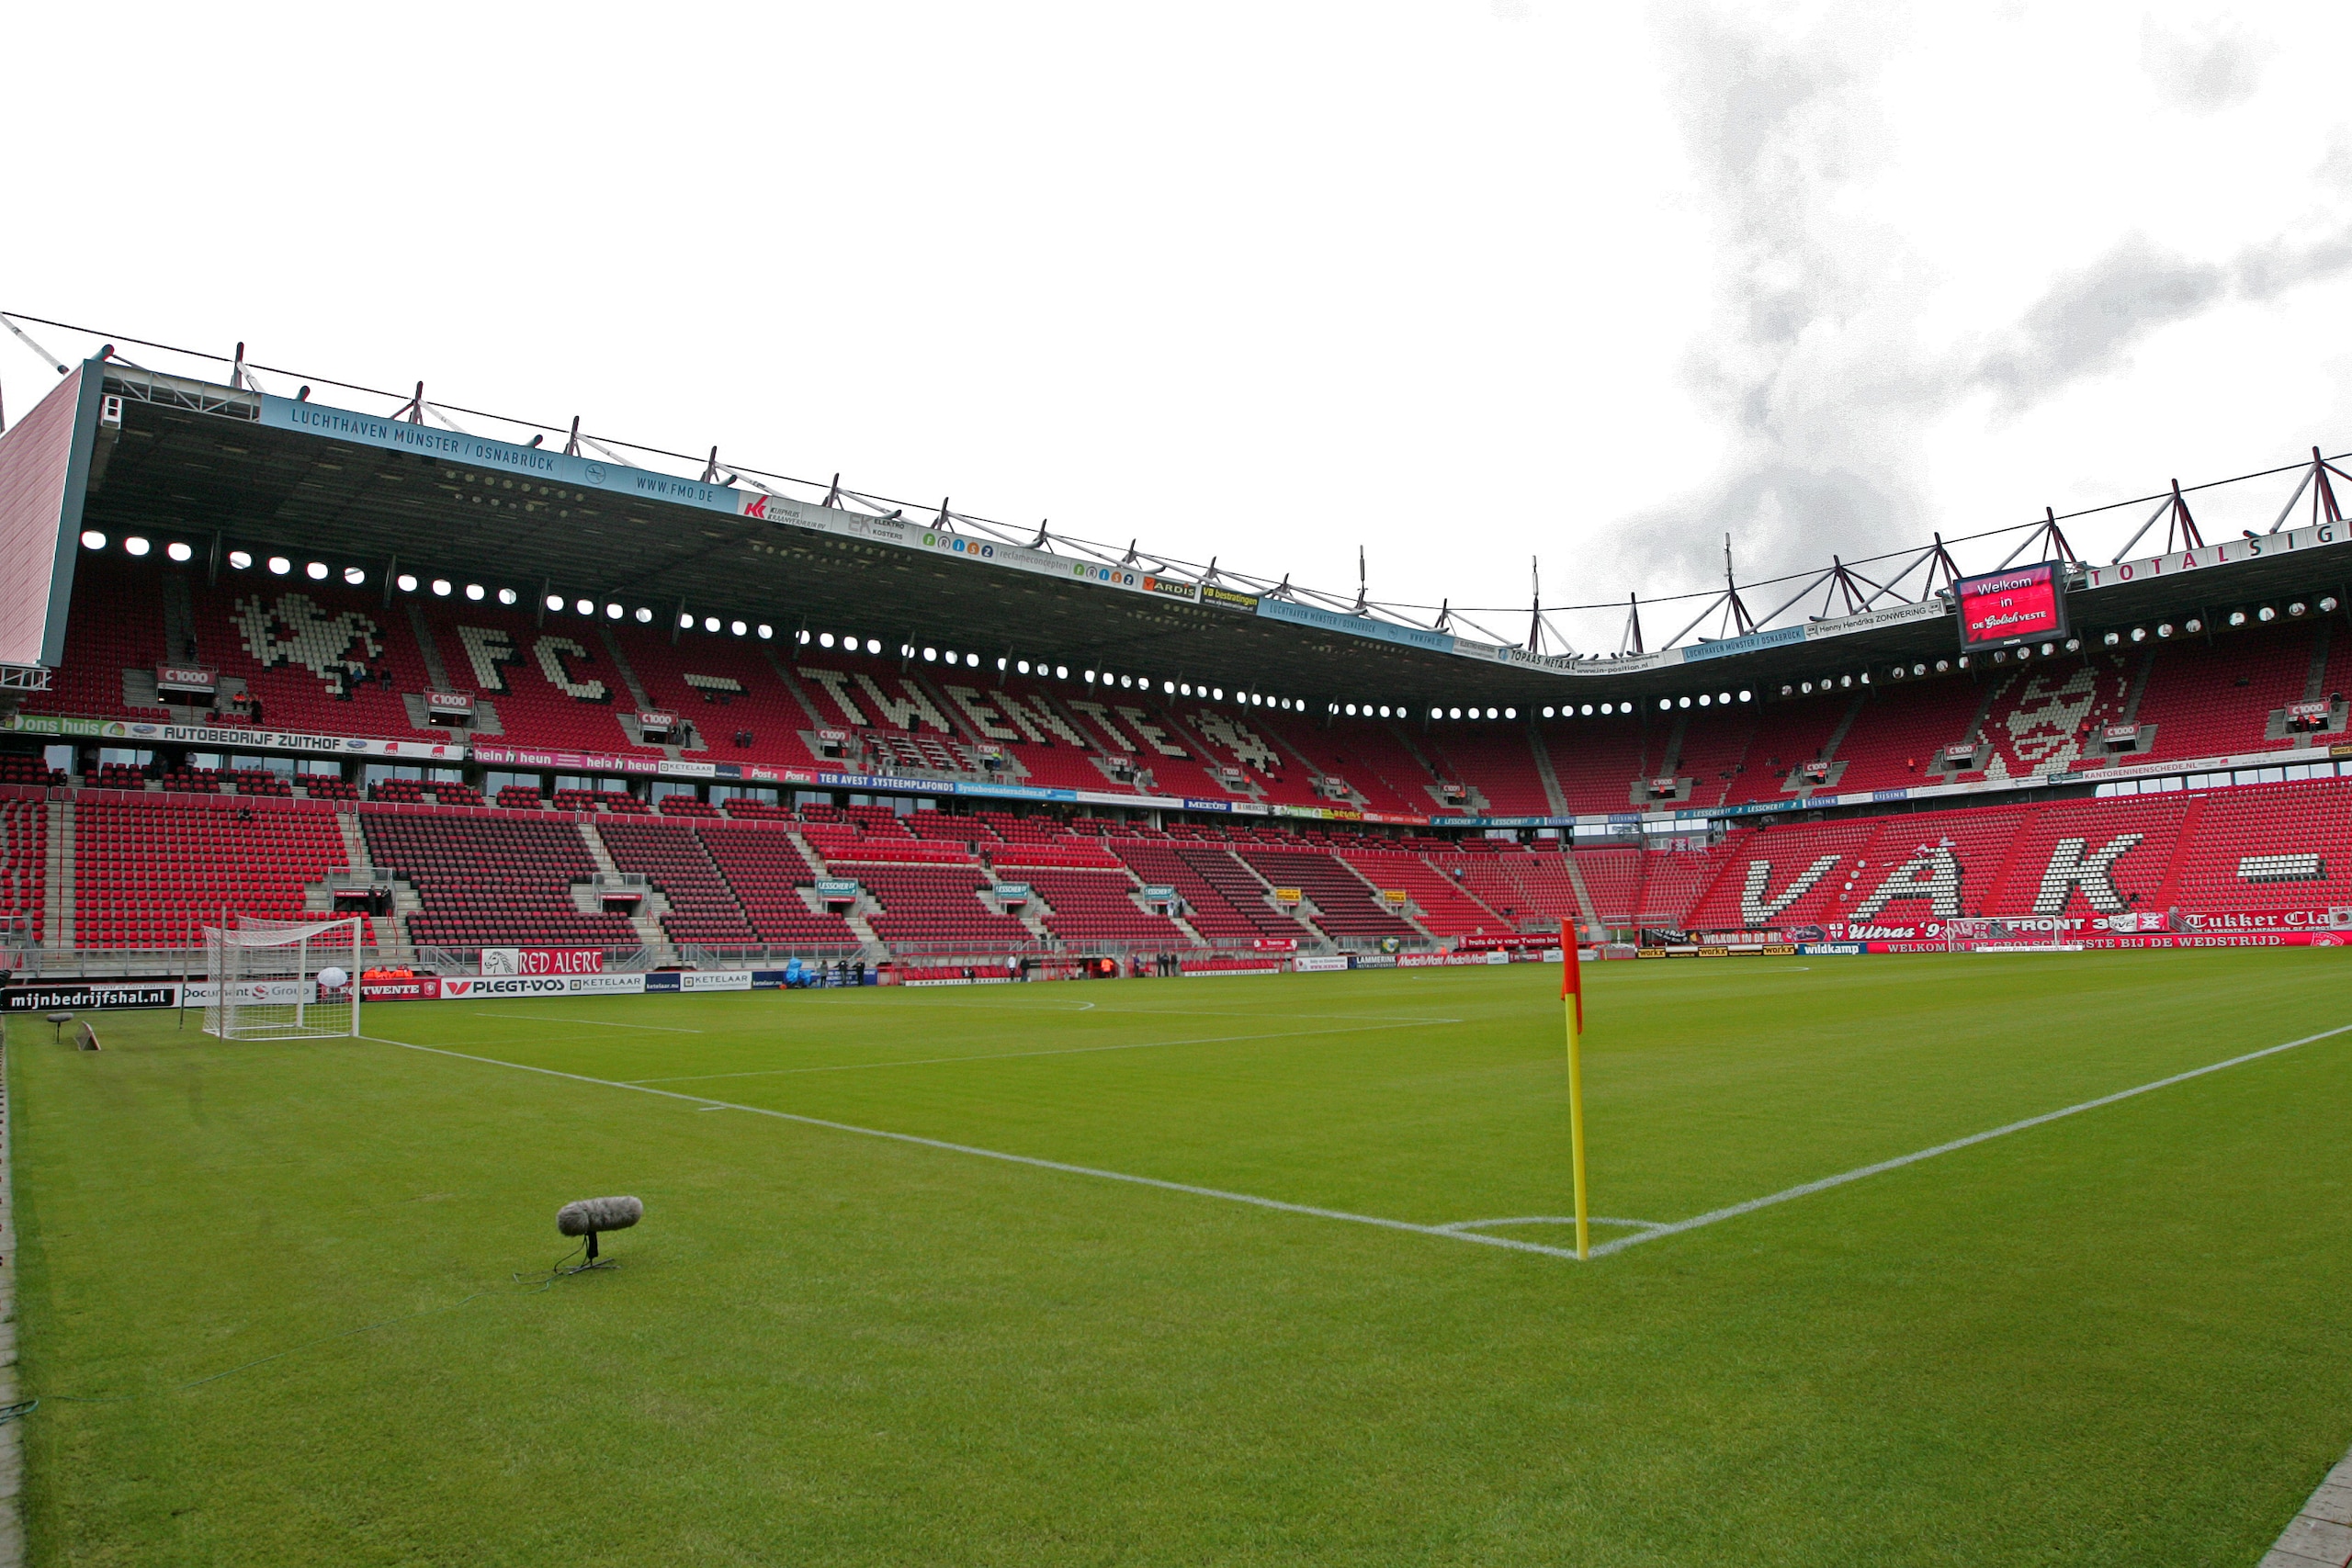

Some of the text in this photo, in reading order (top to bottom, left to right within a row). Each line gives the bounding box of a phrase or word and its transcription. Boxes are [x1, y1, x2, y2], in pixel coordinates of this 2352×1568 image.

[291, 408, 387, 440] LUCHTHAVEN
[394, 428, 458, 454] MÜNSTER
[476, 445, 554, 471] OSNABRÜCK
[637, 476, 714, 502] WWW.FMO.DE
[874, 519, 905, 530] ELEKTRO
[872, 529, 903, 540] KOSTERS
[2090, 522, 2352, 586] TOTALSIG
[1976, 577, 2031, 596] Welkom
[1204, 587, 1214, 597] VB
[1215, 589, 1258, 606] bestratingen
[2000, 596, 2012, 607] in
[1269, 604, 1308, 620] LUCHTHAVEN
[1309, 614, 1337, 626] MÜNSTER
[1342, 619, 1376, 634] OSNABRÜCK
[1819, 606, 1927, 635] Henny Hendriks ZONWERING
[1972, 610, 2047, 629] DE Grolsch VESTE
[1686, 645, 1724, 659] LUCHTHAVEN
[1725, 639, 1755, 653] MÜNSTER
[1761, 631, 1802, 645] OSNABRÜCK
[1511, 649, 1542, 665] TOPAAS
[1543, 657, 1576, 671] METAAL
[1577, 662, 1648, 674] www.in-position.nl
[165, 670, 209, 683] C1000
[432, 694, 467, 706] C1000
[2292, 703, 2324, 715] C1000
[642, 714, 673, 725] C1000
[25, 718, 99, 735] ons huis
[2108, 726, 2134, 736] C1000
[164, 726, 341, 750] AUTOBEDRIJF ZUITHOF
[1949, 745, 1972, 754] C1000
[475, 749, 502, 761] hein
[520, 752, 551, 764] heun
[628, 760, 656, 771] heun
[670, 763, 713, 772] KETELAAR
[2085, 762, 2198, 780] KANTORENINENSCHEDE.NL
[820, 773, 954, 792] TER AVEST SYSTEEMPLAFONDS
[1693, 808, 1725, 818] LESSCHER
[1747, 804, 1779, 812] LESSCHER
[818, 882, 849, 890] LESSCHER
[2007, 919, 2086, 931] FRONT
[2184, 910, 2330, 929] Tukker Cla
[1848, 923, 1916, 940] Ultras
[1919, 921, 1945, 938] '9
[1702, 932, 1739, 944] WELKOM
[1888, 943, 1946, 953] WELKOM
[1951, 942, 1965, 952] IN
[2066, 938, 2115, 949] VESTE
[2120, 938, 2144, 949] BIJ
[2151, 937, 2172, 948] DE
[2178, 935, 2286, 947] WEDSTRIJD:
[1699, 947, 1726, 956] workx
[1765, 945, 1792, 954] workx
[1804, 943, 1860, 954] wildkamp
[518, 951, 603, 974] RED ALERT
[1356, 955, 1396, 964] LAMMERINK
[582, 977, 640, 987] KETELAAR
[695, 975, 748, 983] KETELAAR
[361, 985, 419, 996] TWENTE
[473, 978, 565, 993] PLEGT-VOS
[11, 988, 165, 1010] mijnbedrijfshal.nl
